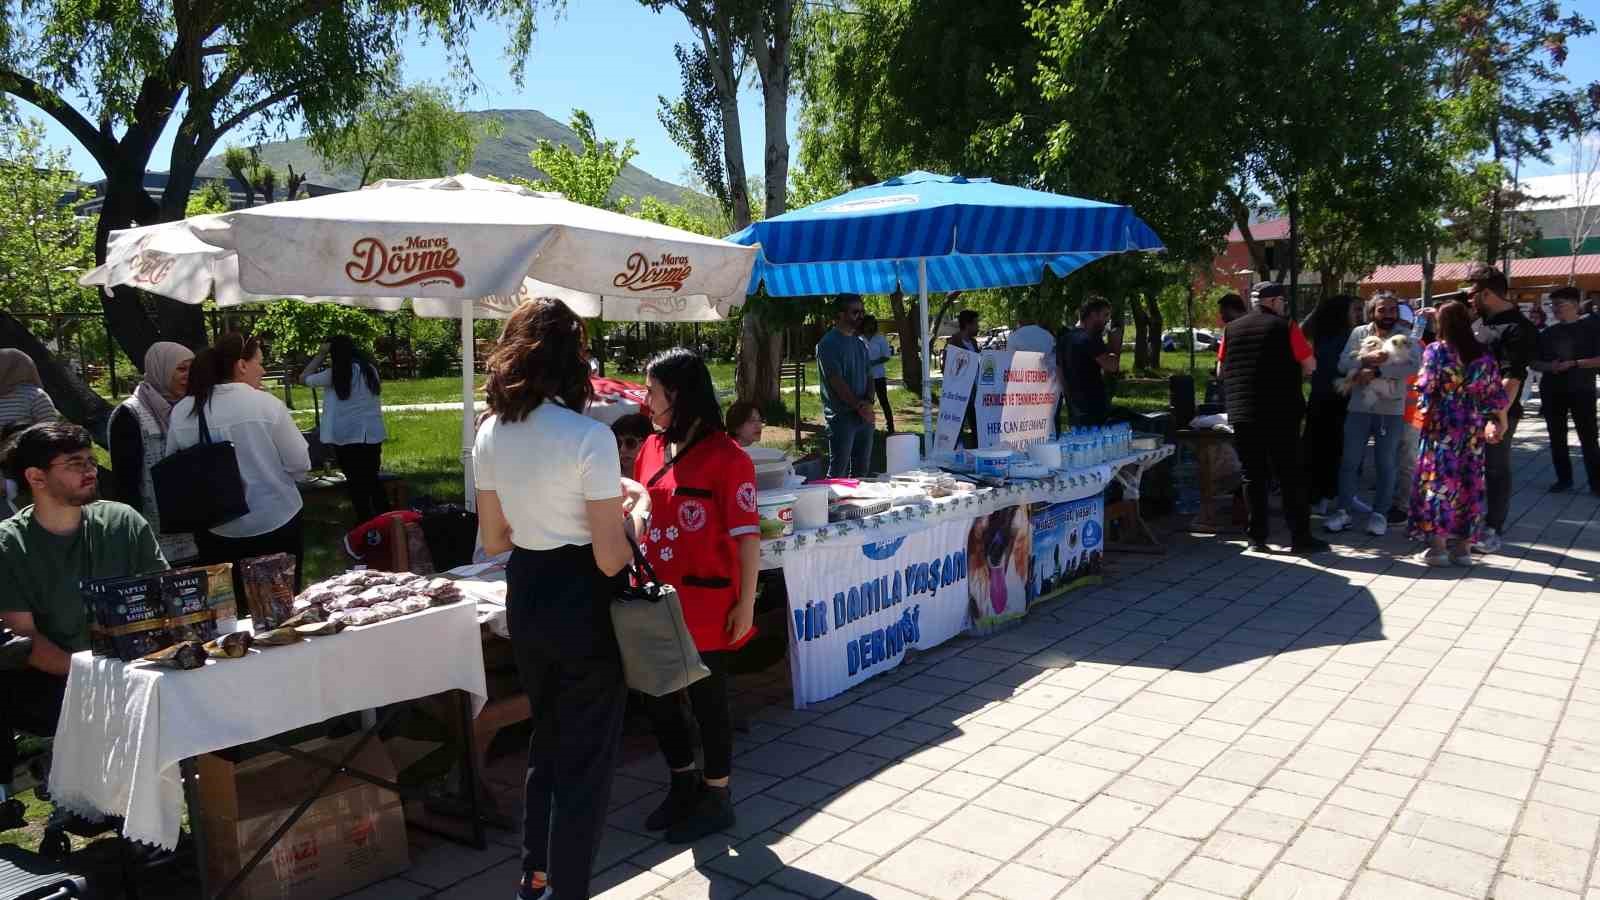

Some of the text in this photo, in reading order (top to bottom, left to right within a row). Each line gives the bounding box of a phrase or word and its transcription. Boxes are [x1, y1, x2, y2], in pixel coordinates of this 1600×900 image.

[407, 236, 448, 250] Maraş
[345, 237, 461, 284] Dövme
[613, 252, 692, 288] Dövme
[660, 253, 688, 266] Maraş
[987, 422, 1002, 434] HER
[1004, 420, 1018, 433] CAN
[833, 570, 902, 630] DAMLA
[905, 548, 967, 597] YAŞAM
